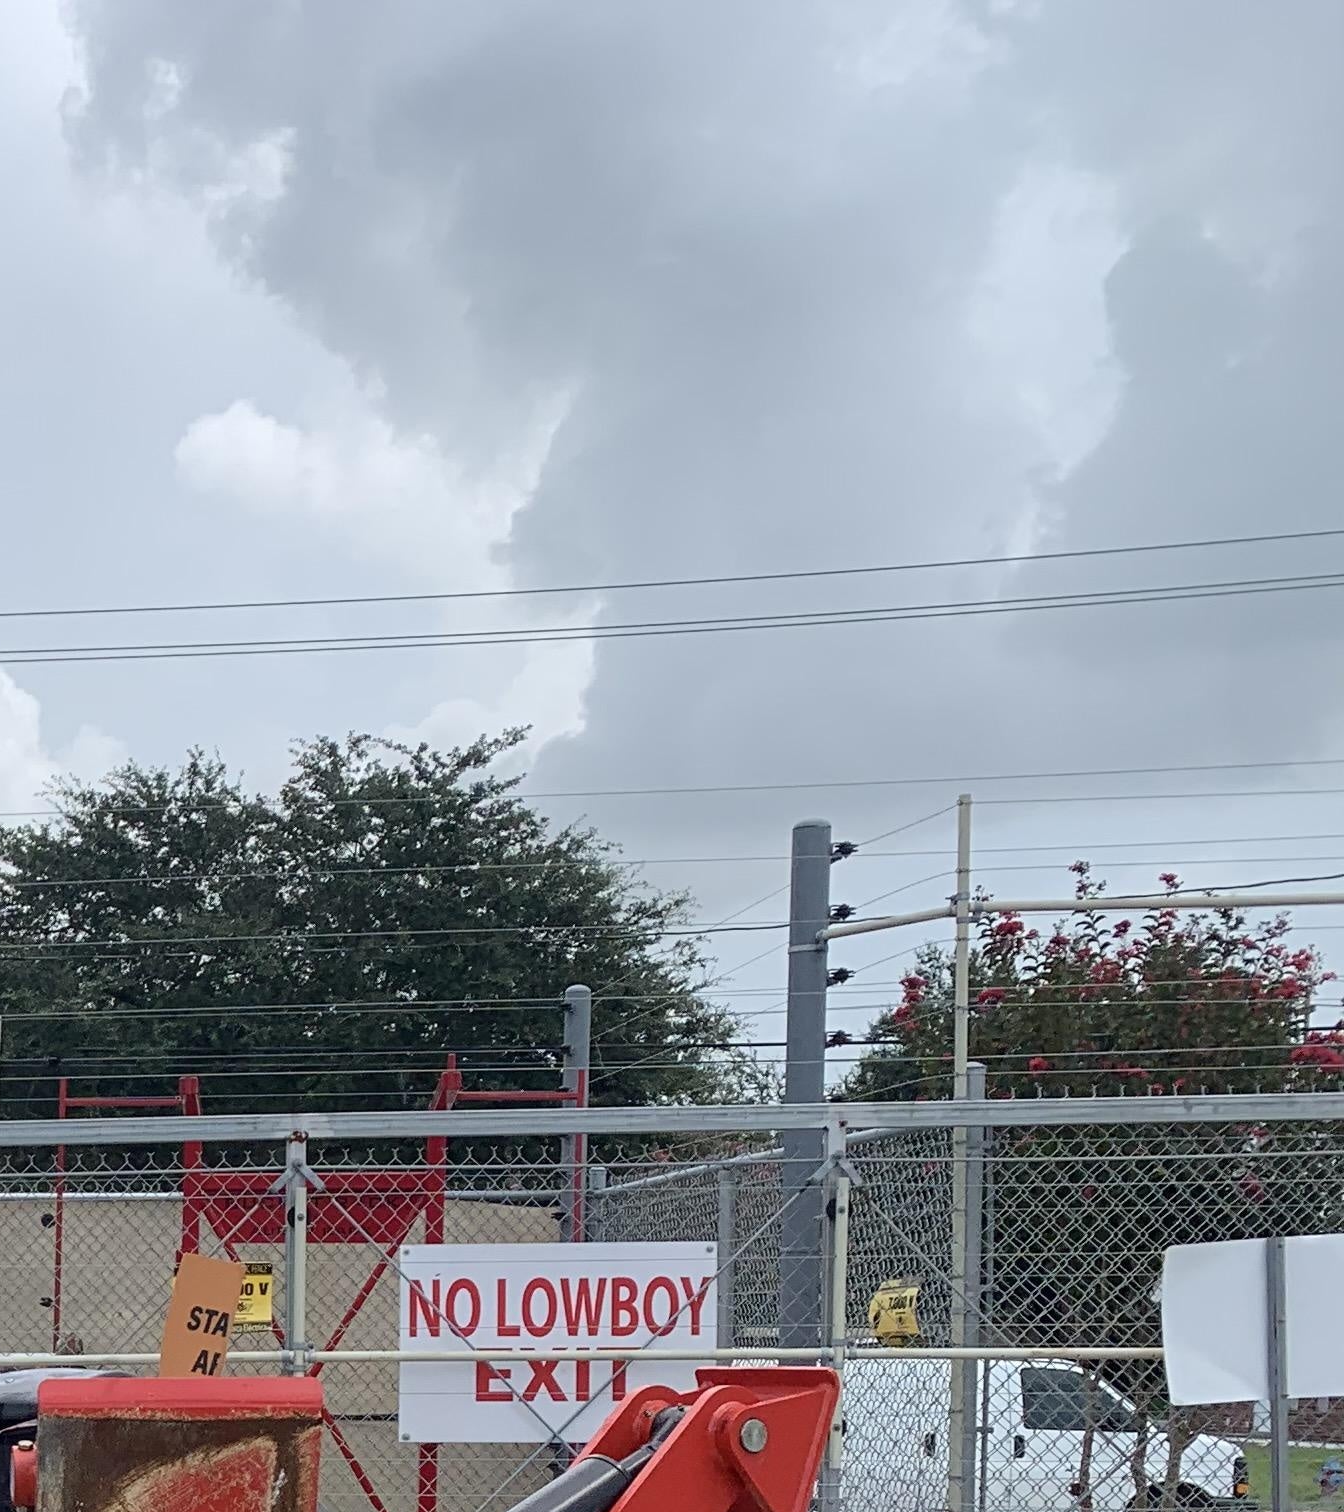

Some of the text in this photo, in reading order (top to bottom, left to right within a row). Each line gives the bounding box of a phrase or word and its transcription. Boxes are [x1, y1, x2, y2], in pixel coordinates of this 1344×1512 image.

[259, 1282, 269, 1296] V
[408, 1276, 713, 1338] NO LOWBOY
[187, 1305, 230, 1338] STA
[473, 1346, 644, 1403] EXIT
